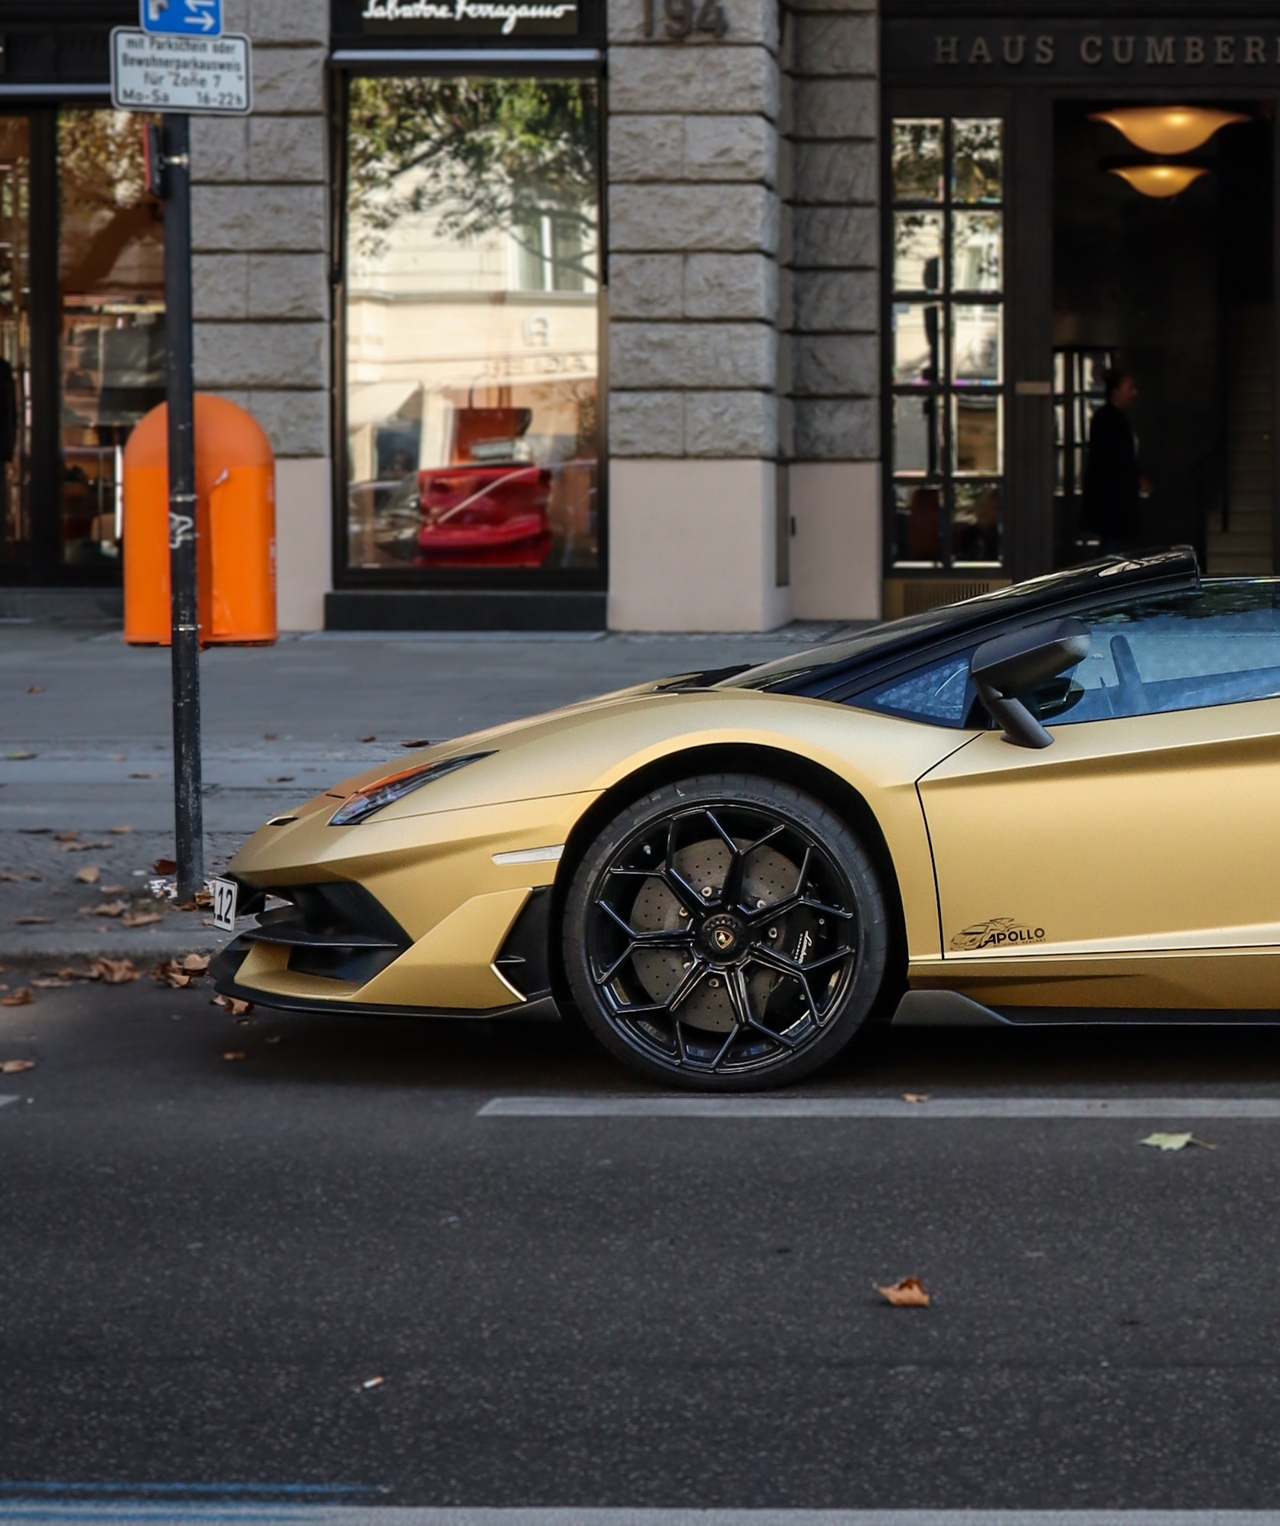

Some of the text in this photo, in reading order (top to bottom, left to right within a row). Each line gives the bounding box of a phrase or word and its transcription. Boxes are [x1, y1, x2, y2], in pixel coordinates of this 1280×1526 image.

[362, 0, 577, 35] Salvatore Ferragamo
[126, 36, 236, 55] mit Parkschein oder
[935, 36, 1055, 65] HAUS
[121, 52, 242, 73] Bewohnerparkausweis
[143, 71, 222, 89] für Zone 7
[122, 88, 170, 103] Mo-Sa
[213, 886, 234, 924] 12
[982, 928, 1045, 946] APOLLO
